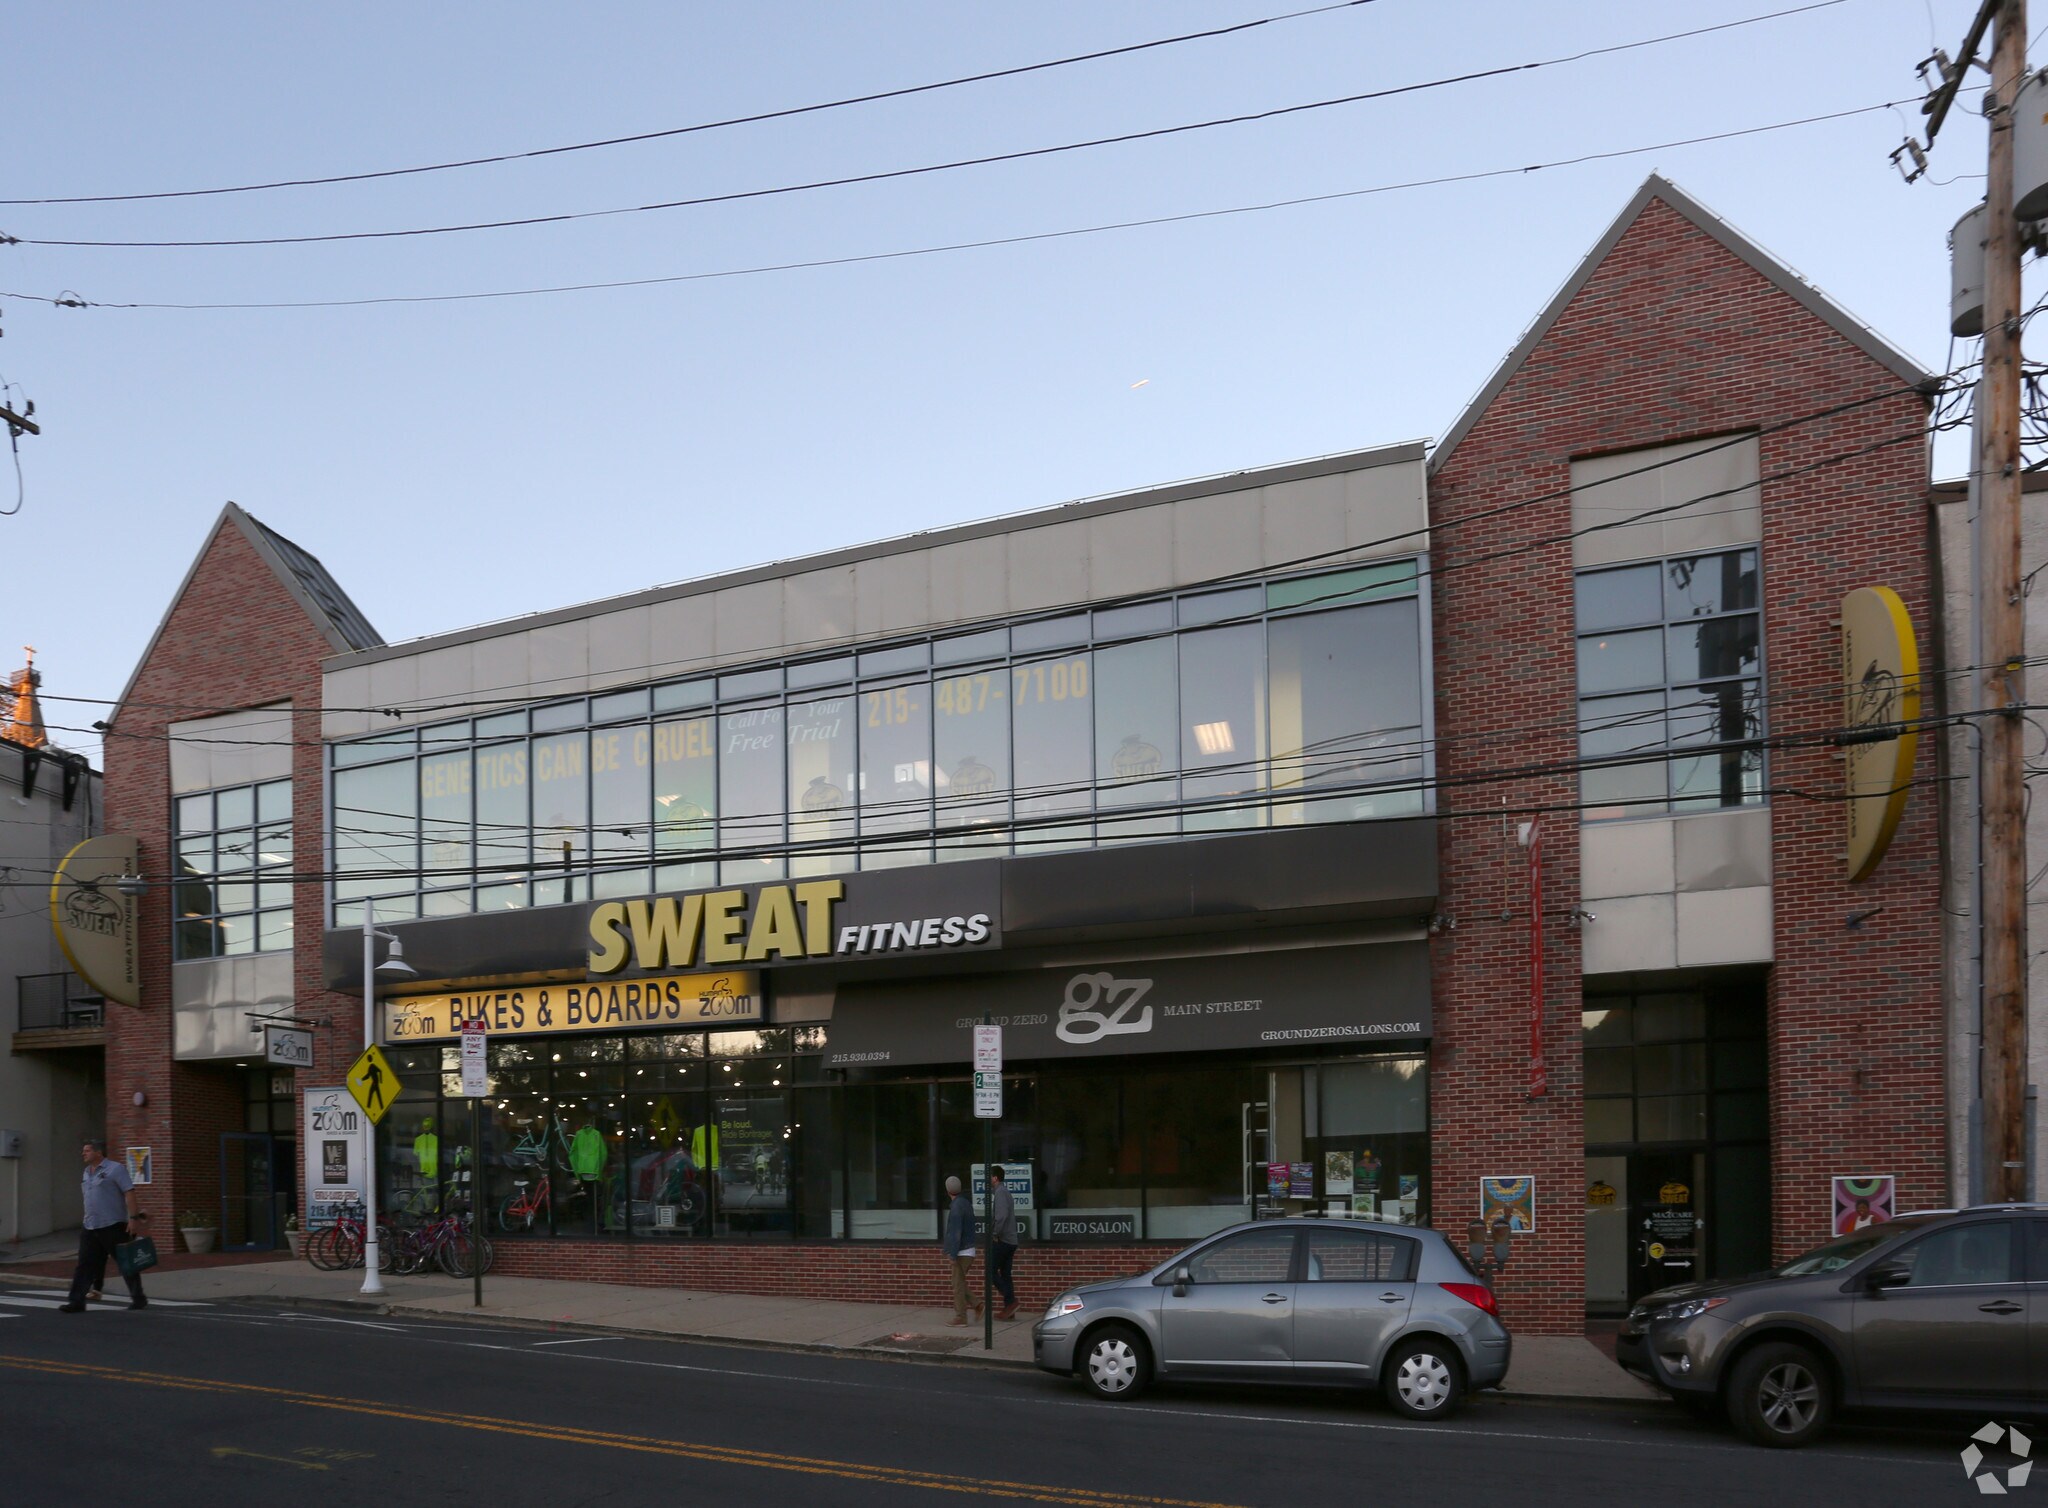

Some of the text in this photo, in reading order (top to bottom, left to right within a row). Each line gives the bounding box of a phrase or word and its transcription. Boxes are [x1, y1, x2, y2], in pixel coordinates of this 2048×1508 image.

[868, 660, 1088, 728] 215- 487- 7100
[727, 701, 844, 730] Call For Your
[726, 720, 842, 754] Free Trial
[422, 720, 713, 799] GENETICS CAN BE CRUEL
[68, 909, 120, 937] SWEAT
[589, 880, 844, 973] SWEAT
[837, 914, 991, 953] FITNESS
[450, 980, 681, 1032] BIKES & BOARDS
[1163, 999, 1263, 1016] MAIN STREET
[469, 1021, 479, 1029] NO
[1012, 1013, 1048, 1026] ZERO
[1260, 1022, 1421, 1041] GROUNDZEROSALONS.COM
[831, 1051, 891, 1063] 215.930.0394
[976, 1074, 982, 1087] 2
[733, 1120, 752, 1128] loud.
[1053, 1221, 1132, 1234] ZERO SALON
